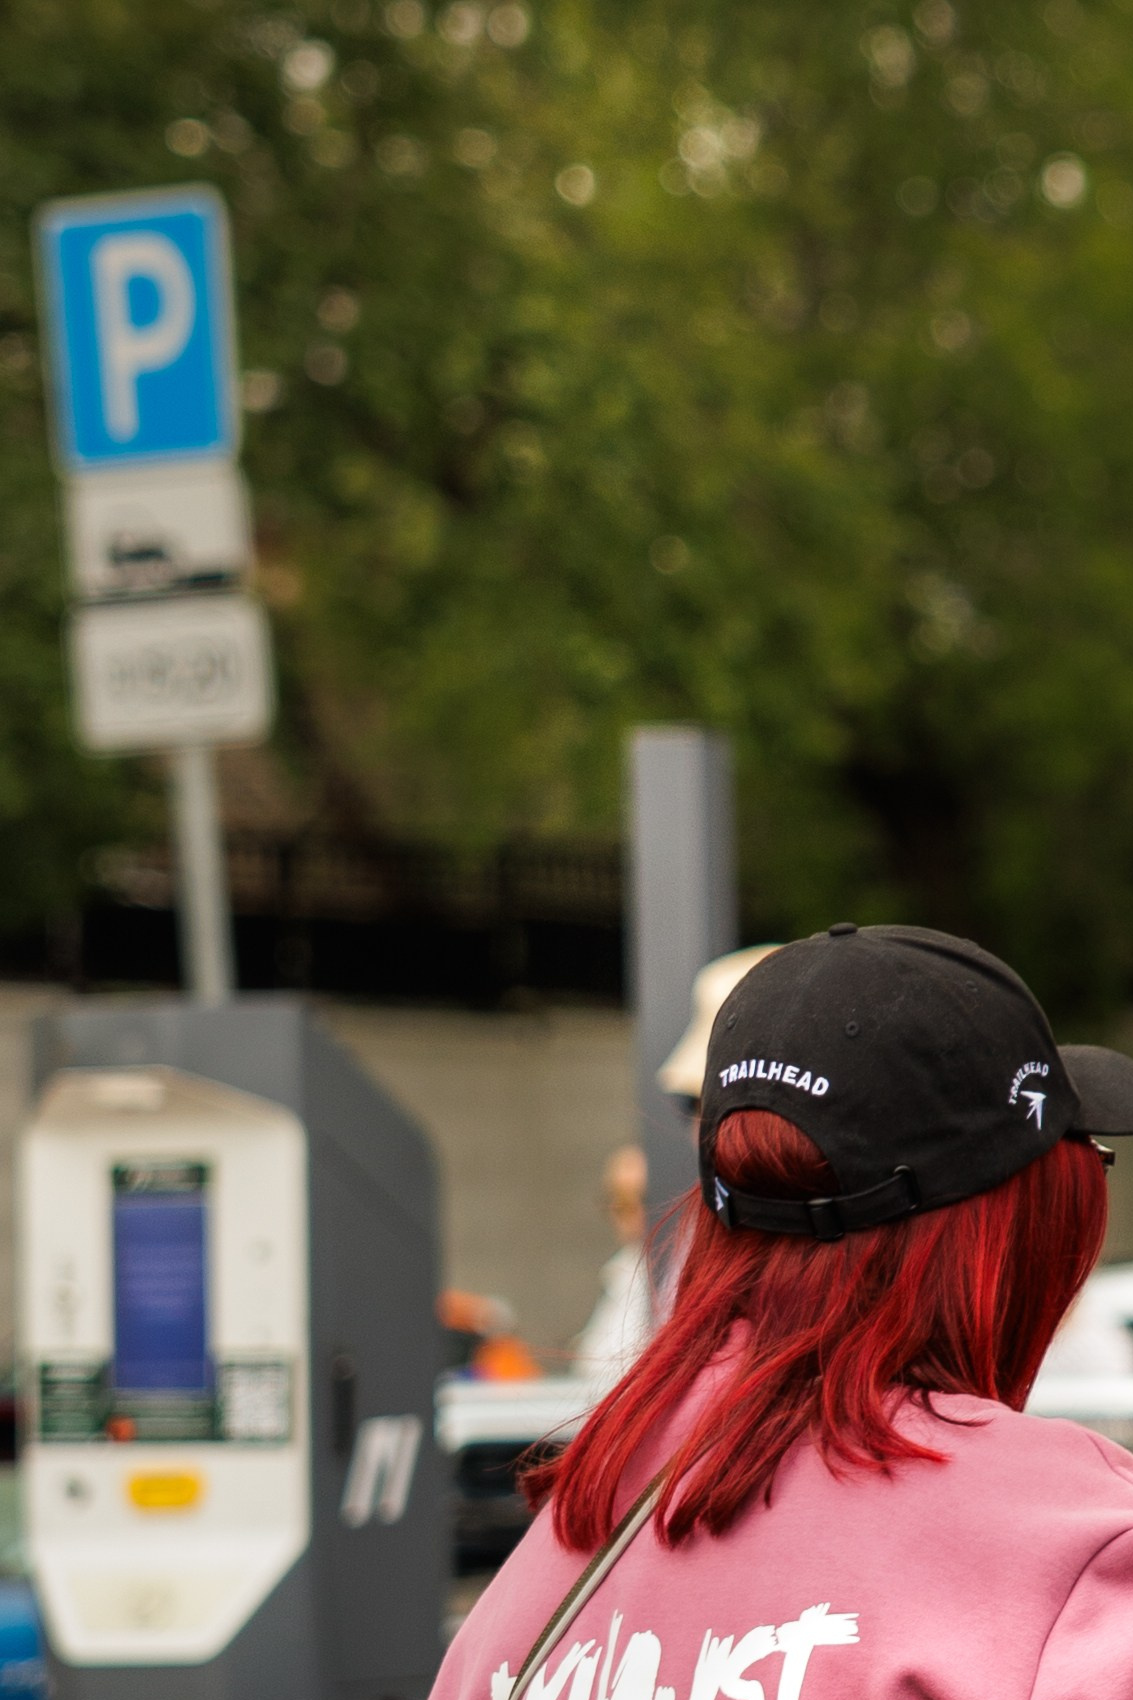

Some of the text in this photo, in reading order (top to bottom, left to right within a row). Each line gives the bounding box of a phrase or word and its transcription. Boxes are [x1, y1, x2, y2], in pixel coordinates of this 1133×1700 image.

[90, 229, 197, 444] P
[719, 1058, 830, 1096] TRAILHEAD
[1008, 1061, 1050, 1105] TRAILHEAD
